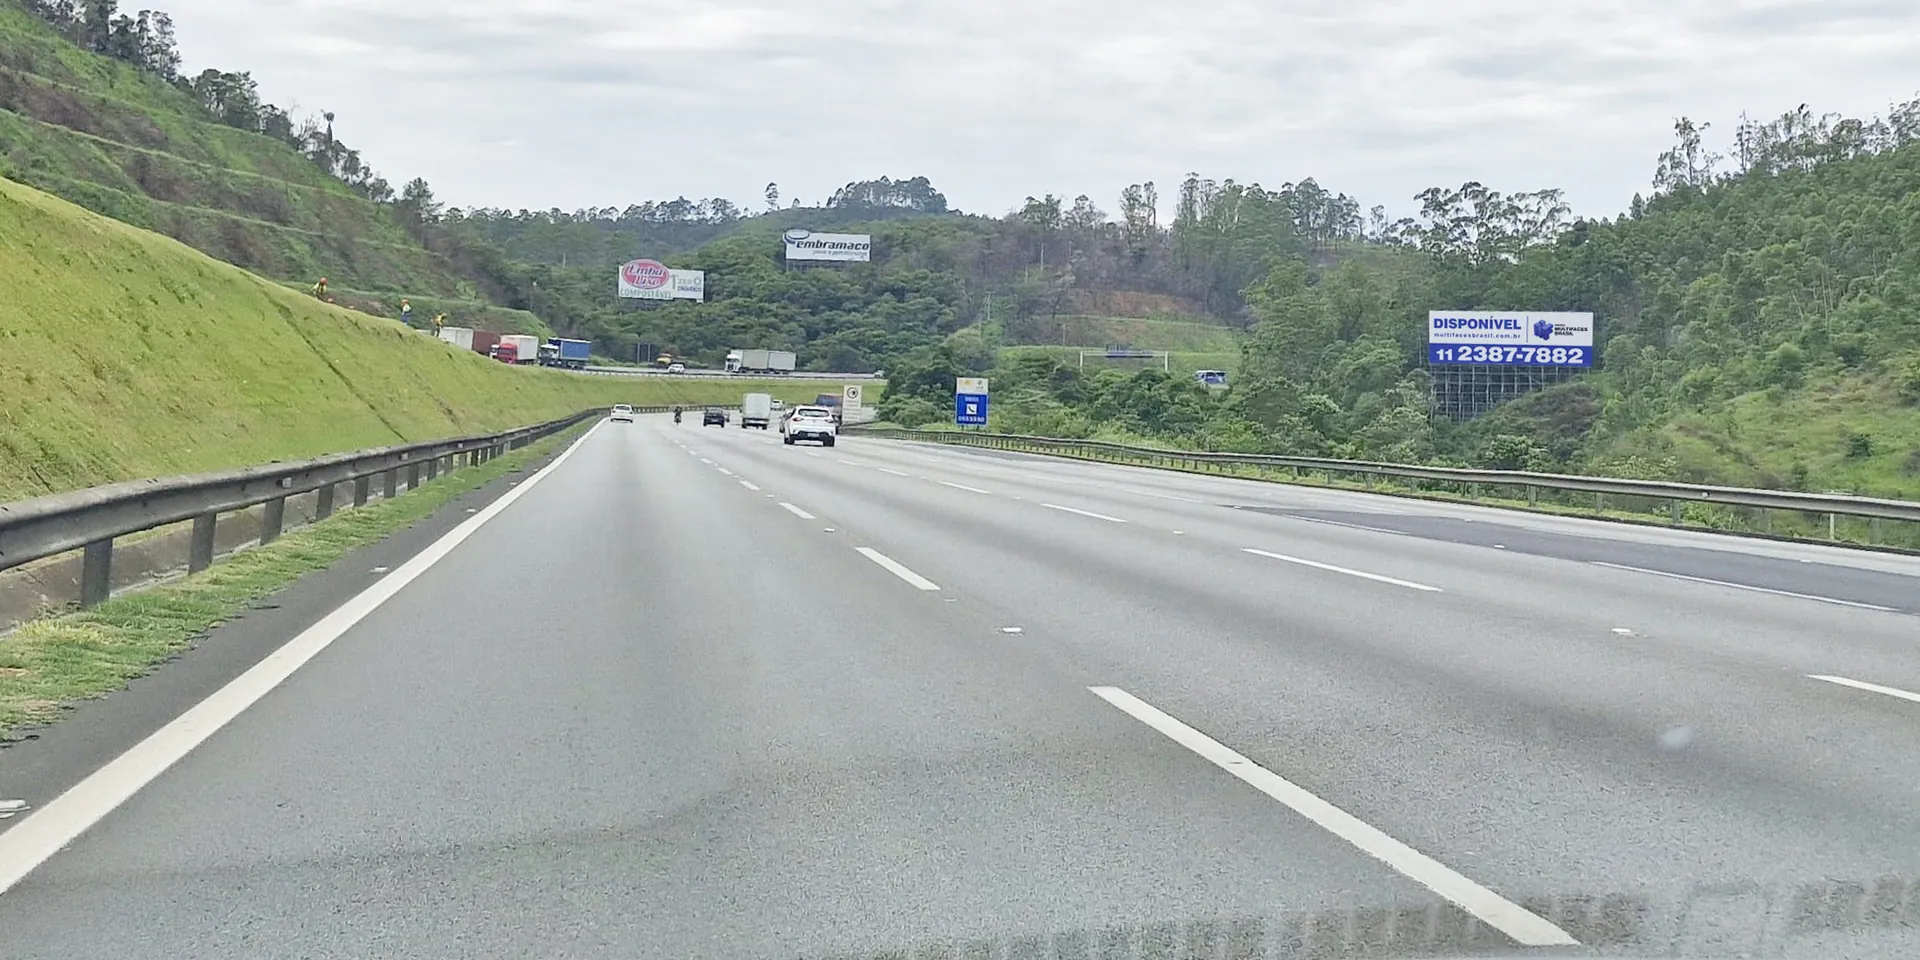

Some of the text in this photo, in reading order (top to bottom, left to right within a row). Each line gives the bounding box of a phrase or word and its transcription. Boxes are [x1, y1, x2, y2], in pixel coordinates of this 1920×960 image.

[796, 240, 869, 250] embramaco
[620, 288, 672, 298] COMPOSTÁVEL
[1433, 315, 1521, 330] DISPONÍVEL
[1436, 345, 1584, 364] 11 2387-7882
